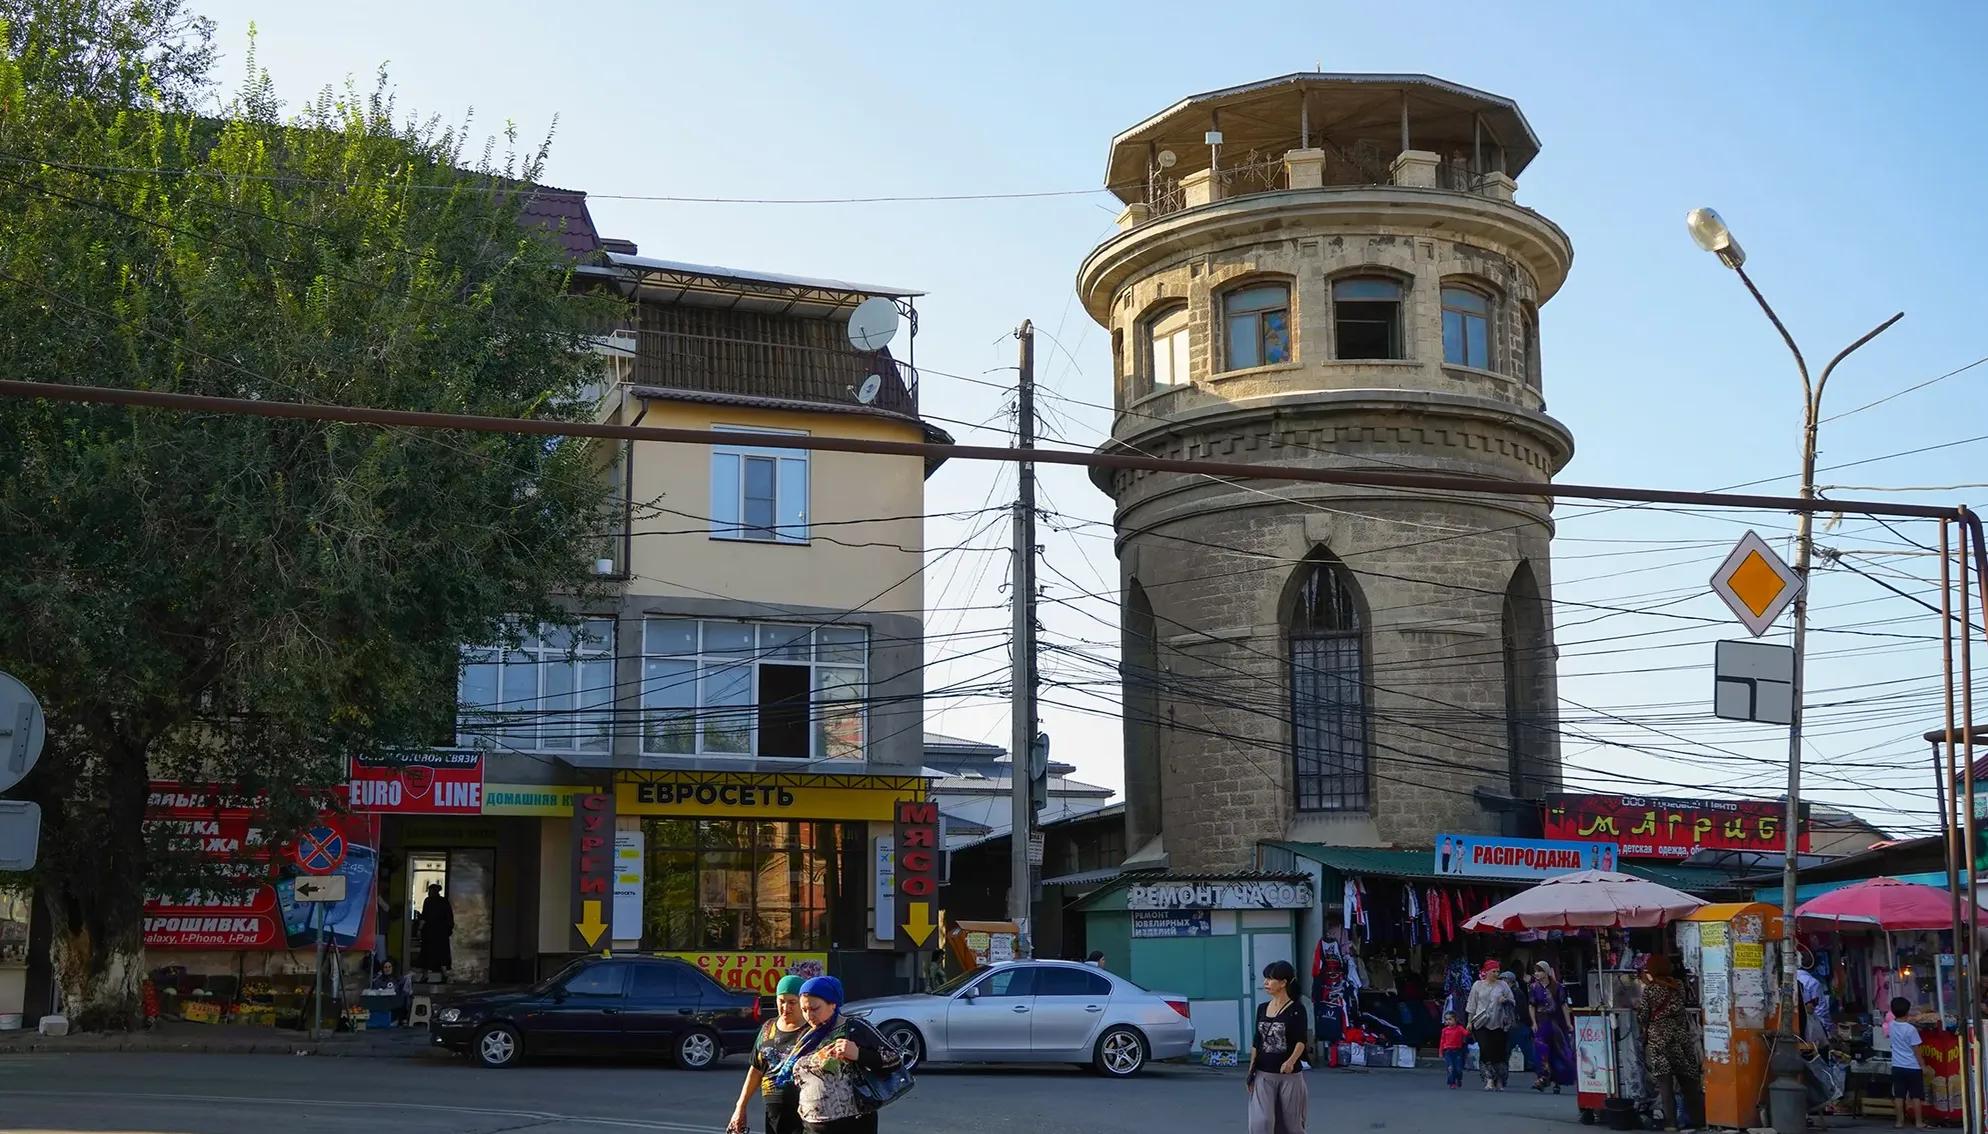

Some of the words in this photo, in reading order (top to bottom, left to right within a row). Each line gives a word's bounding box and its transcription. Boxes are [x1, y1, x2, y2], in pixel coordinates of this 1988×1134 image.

[446, 754, 479, 763] СВЯЗИ
[351, 780, 402, 806] EURO
[434, 782, 480, 807] LINE
[486, 793, 558, 806] ДОМАШНЯЯ
[638, 783, 794, 806] ЕВРОСЕТЬ
[581, 795, 610, 894] СУРГИ
[900, 802, 938, 896] МЯСО
[1473, 844, 1581, 869] РАСПРОДАЖА
[1130, 886, 1223, 908] РЕМОНТ
[1134, 911, 1169, 920] РЕМОНТ
[1135, 919, 1191, 929] ЮВЕЛИРНЫХ
[229, 934, 258, 943] I-Pad
[1135, 927, 1178, 937] ИЗДЕЛИЙ
[697, 956, 786, 968] СУРГИ
